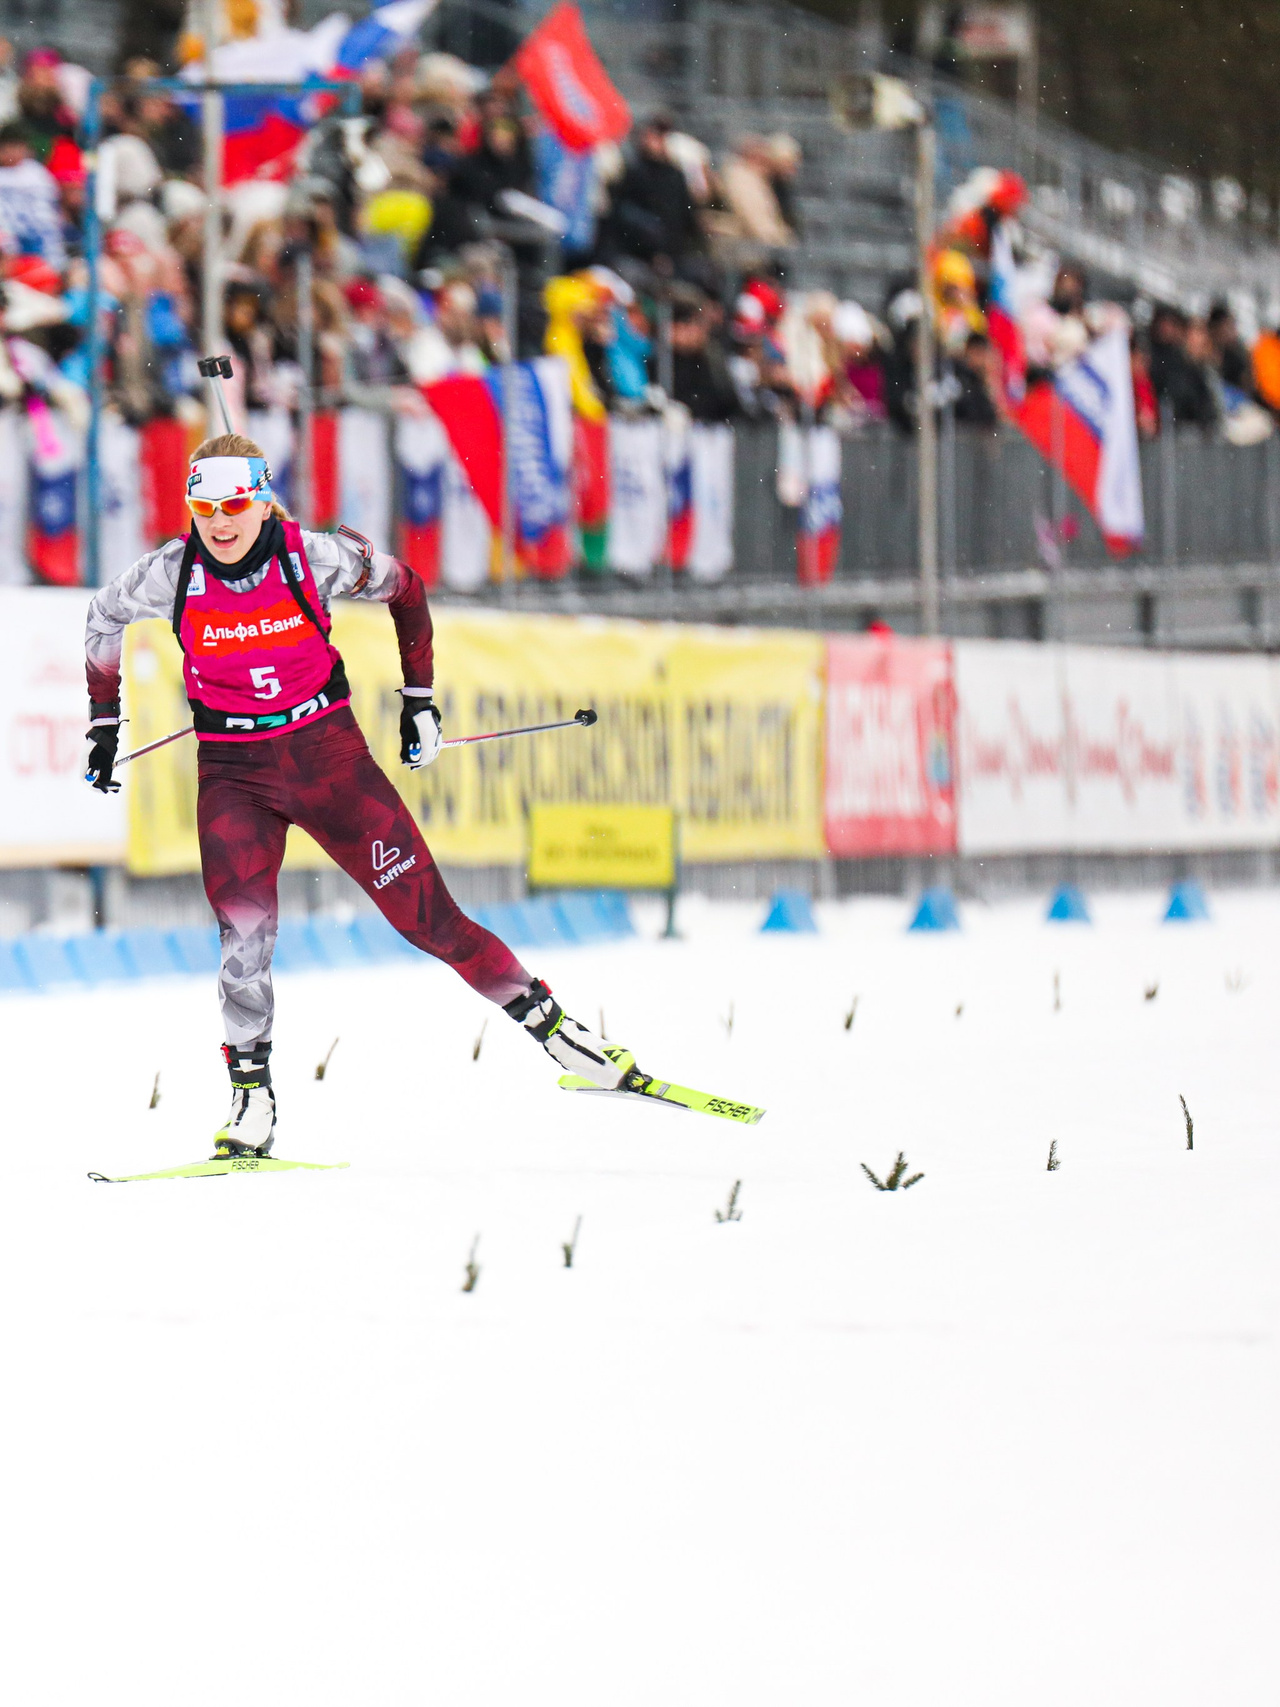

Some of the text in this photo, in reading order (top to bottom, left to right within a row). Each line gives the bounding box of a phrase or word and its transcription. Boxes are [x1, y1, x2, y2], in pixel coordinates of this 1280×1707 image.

[202, 613, 304, 645] Альфа Банк
[249, 665, 282, 700] 5
[372, 854, 416, 890] Löffler
[703, 1098, 751, 1120] FISCHER
[231, 1160, 260, 1171] FISCHER
